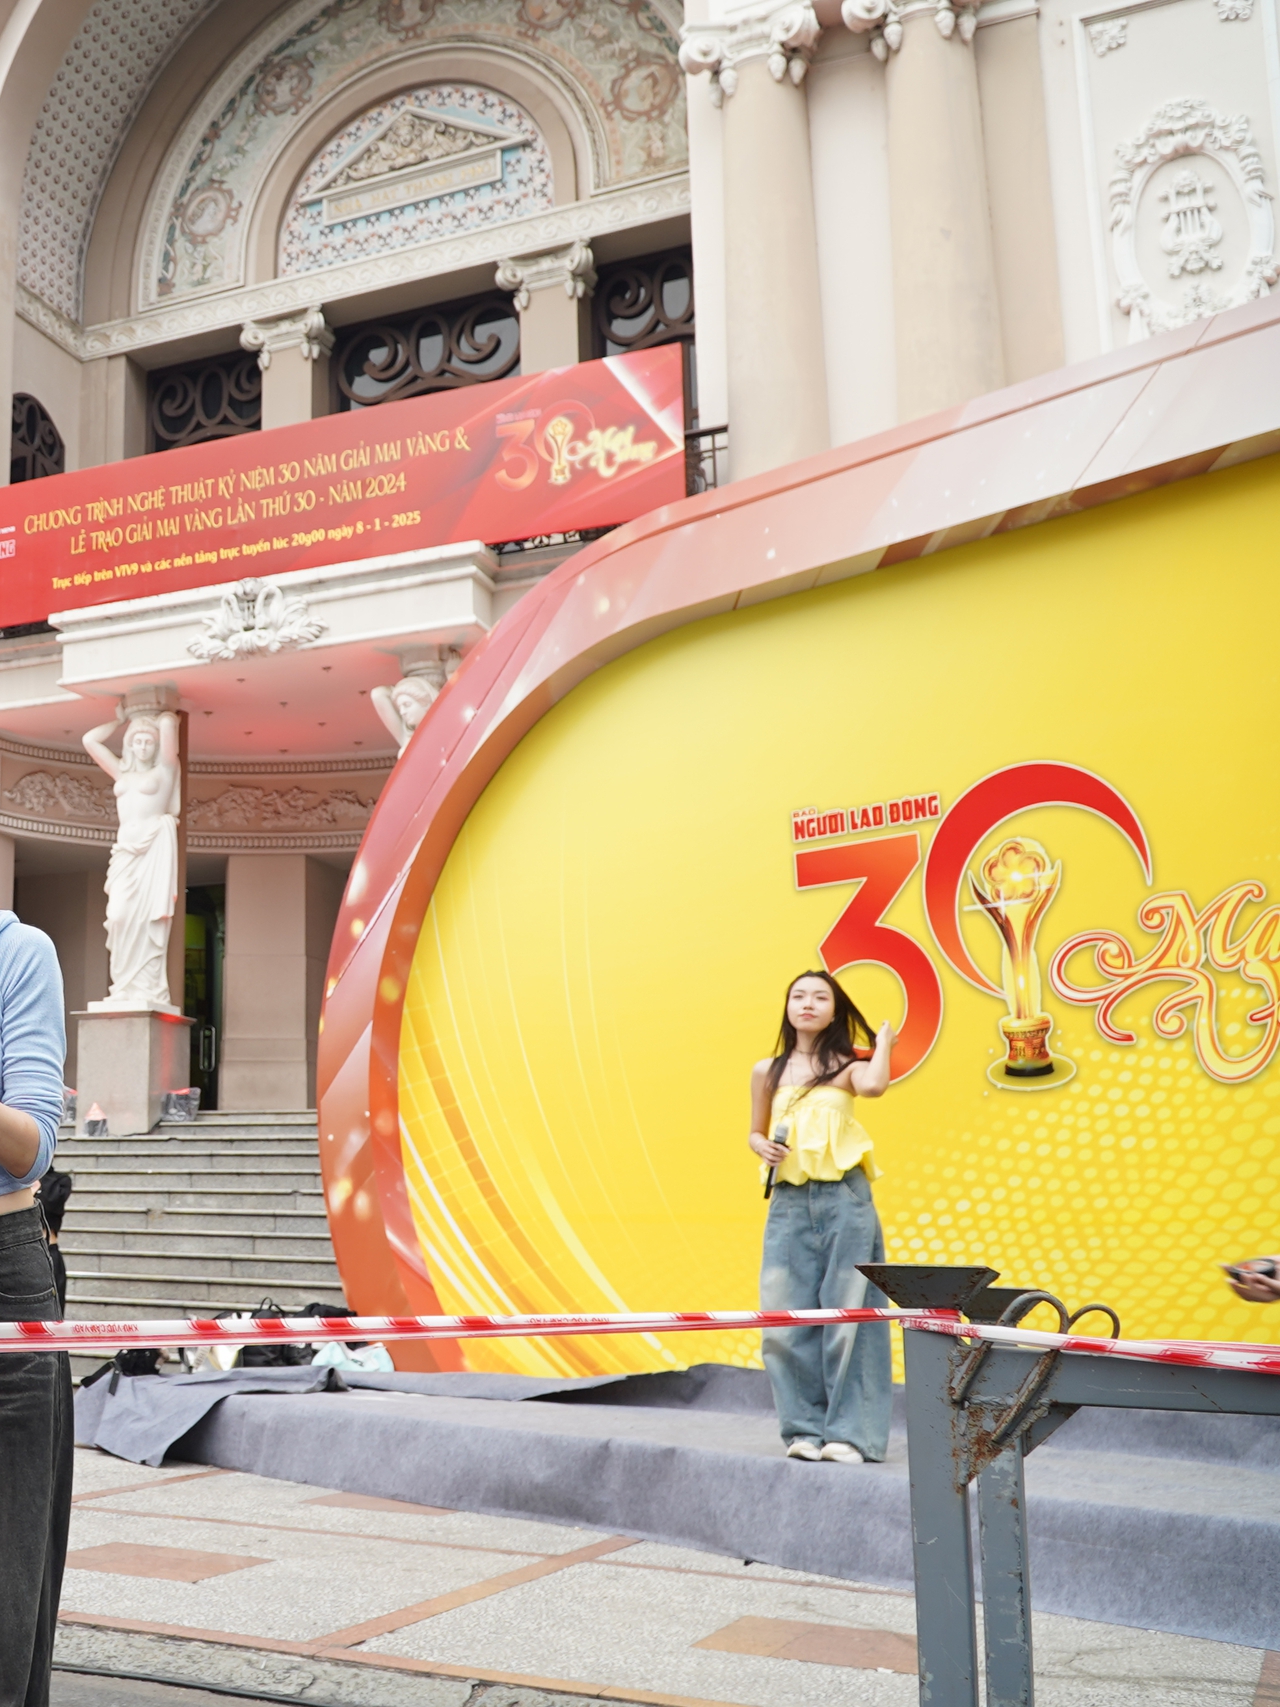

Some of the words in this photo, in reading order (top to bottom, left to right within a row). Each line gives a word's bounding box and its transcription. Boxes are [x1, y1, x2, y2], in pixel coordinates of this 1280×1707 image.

[85, 496, 124, 524] TRÌNH
[127, 485, 166, 514] NGHỆ
[169, 477, 215, 505] THUẬT
[218, 468, 235, 499] KỶ
[239, 465, 275, 492] NIỆM
[278, 461, 300, 486] 30
[304, 453, 337, 479] NĂM
[340, 441, 371, 471] GIẢI
[374, 440, 401, 465] MAI
[406, 430, 451, 458] VÀNG
[454, 426, 472, 451] &
[90, 526, 123, 553] TRAO
[125, 515, 153, 544] GIẢI
[156, 515, 180, 539] MAI
[184, 507, 223, 532] VÀNG
[227, 497, 256, 525] LẦN
[260, 490, 292, 519] THỨ
[294, 489, 317, 514] 30
[329, 479, 363, 506] NĂM
[366, 471, 407, 499] 2024
[52, 576, 72, 590] Trực
[74, 570, 92, 586] tiếp
[94, 568, 113, 583] trên
[114, 562, 139, 577] VTV9
[140, 560, 153, 574] và
[154, 557, 171, 572] các
[174, 552, 192, 568] nền
[195, 549, 218, 564] tảng
[220, 544, 239, 560] trực
[242, 538, 270, 557] tuyến
[273, 535, 289, 550] lúc
[291, 529, 325, 547] 20g00
[328, 524, 354, 542] ngày
[356, 520, 364, 534] 8
[374, 517, 381, 531] 1
[392, 510, 421, 528] 2025
[793, 810, 846, 841] NGƯỜI
[850, 805, 884, 831] LAO
[889, 795, 940, 824] ĐỘNG
